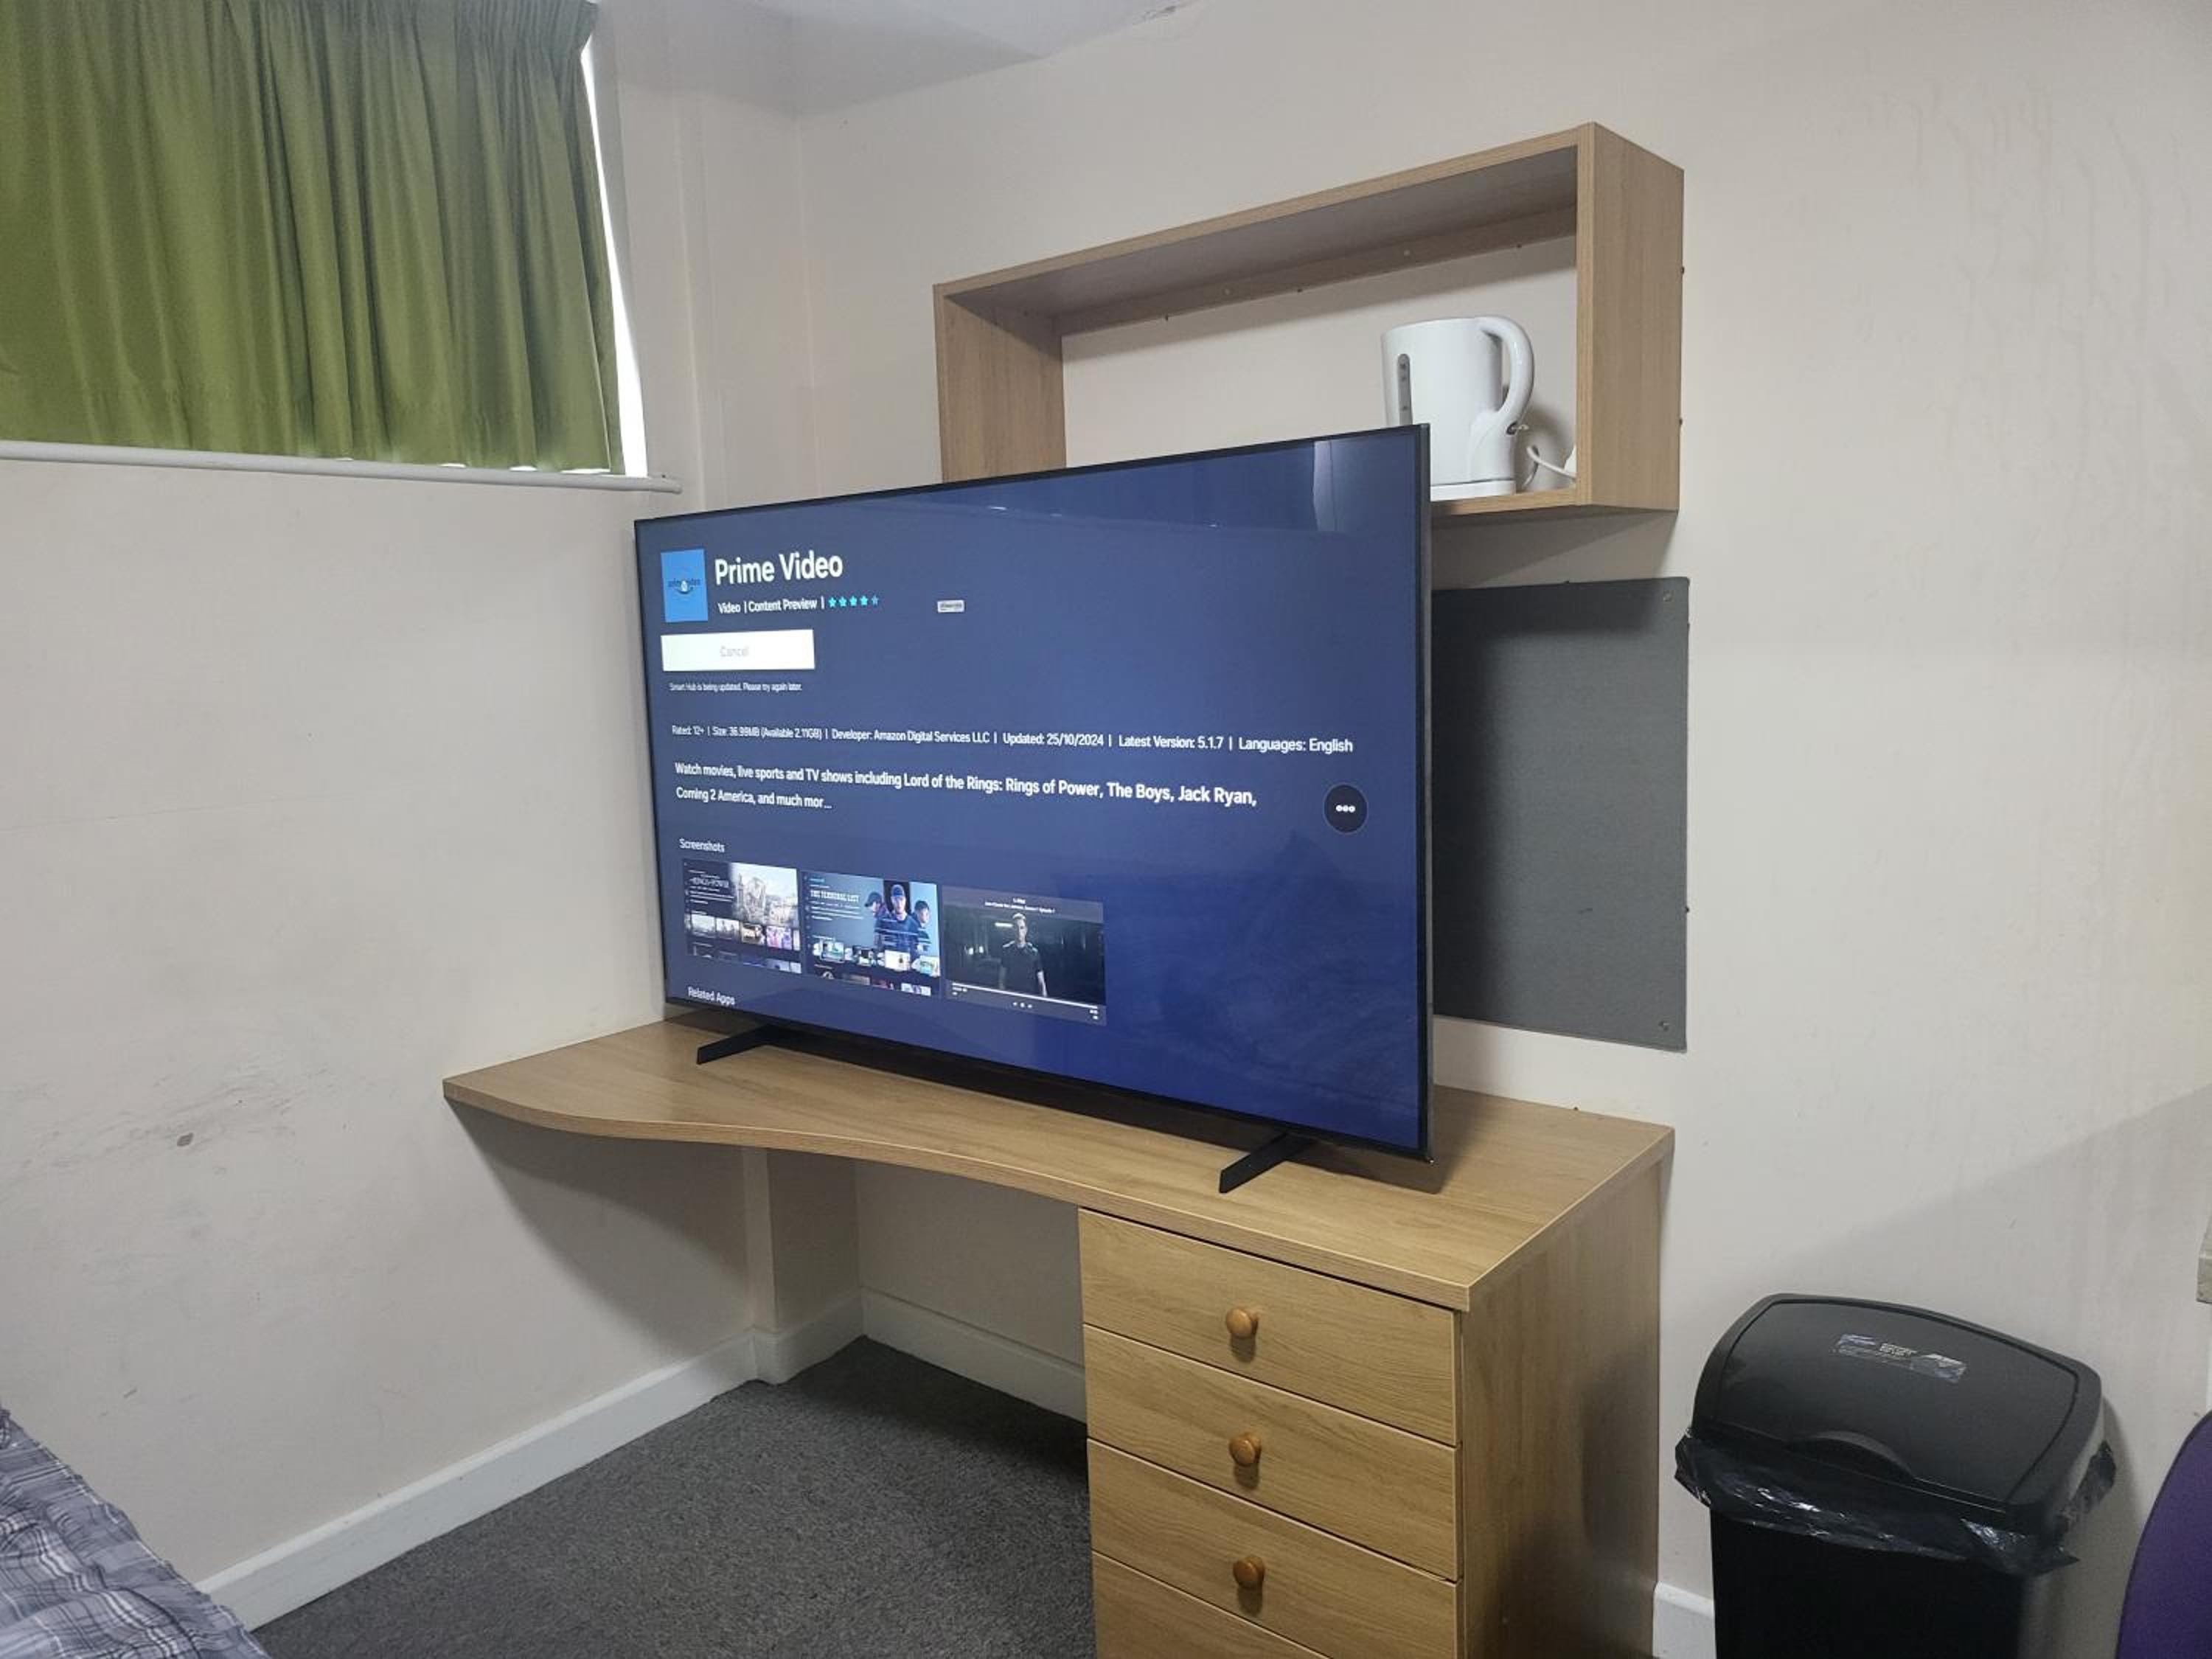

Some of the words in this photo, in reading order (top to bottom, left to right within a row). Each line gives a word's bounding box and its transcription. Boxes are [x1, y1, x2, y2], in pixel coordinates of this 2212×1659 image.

[714, 556, 775, 587] Prime
[779, 549, 844, 582] Video
[717, 601, 741, 614] Video
[748, 599, 782, 613] Content
[782, 597, 818, 611] Preview
[720, 645, 750, 658] Cancel
[703, 682, 718, 693] being
[742, 682, 762, 692] Please
[762, 683, 771, 692] try
[771, 682, 787, 693] again
[761, 727, 793, 740] (Available
[832, 728, 872, 742] Developer:
[874, 728, 906, 741] Amazon
[907, 729, 933, 744] Digital
[934, 730, 970, 743] Services
[972, 731, 990, 743] LLC
[1003, 732, 1045, 747] Updated:
[1046, 733, 1104, 747] 25/10/2024
[1119, 734, 1152, 748] Latest
[1154, 735, 1195, 748] Version:
[1197, 736, 1225, 749] 5.1.7
[1238, 737, 1307, 754] Languages:
[1309, 738, 1353, 754] English
[675, 762, 701, 775] Watch
[703, 764, 737, 779] movies,
[737, 765, 753, 777] live
[754, 768, 784, 782] sports
[786, 768, 804, 781] and
[805, 768, 820, 782] TV
[821, 769, 853, 783] shows
[855, 771, 902, 790] including
[903, 773, 929, 788] Lord
[931, 773, 943, 788] of
[945, 775, 964, 790] the
[967, 776, 1003, 794] Rings:
[1005, 777, 1040, 797] Rings
[1042, 779, 1056, 794] of
[1058, 779, 1104, 799] Power,
[1107, 782, 1133, 799] The
[1135, 783, 1175, 803] Boys,
[1178, 785, 1211, 802] Jack
[1214, 787, 1257, 807] Ryan,
[675, 786, 709, 803] Coming
[710, 788, 716, 801] 2
[717, 789, 756, 805] America,
[757, 791, 775, 805] and
[776, 793, 803, 807] much
[679, 838, 725, 853] Screenshots
[688, 986, 714, 1001] Related
[716, 992, 735, 1007] Apps
